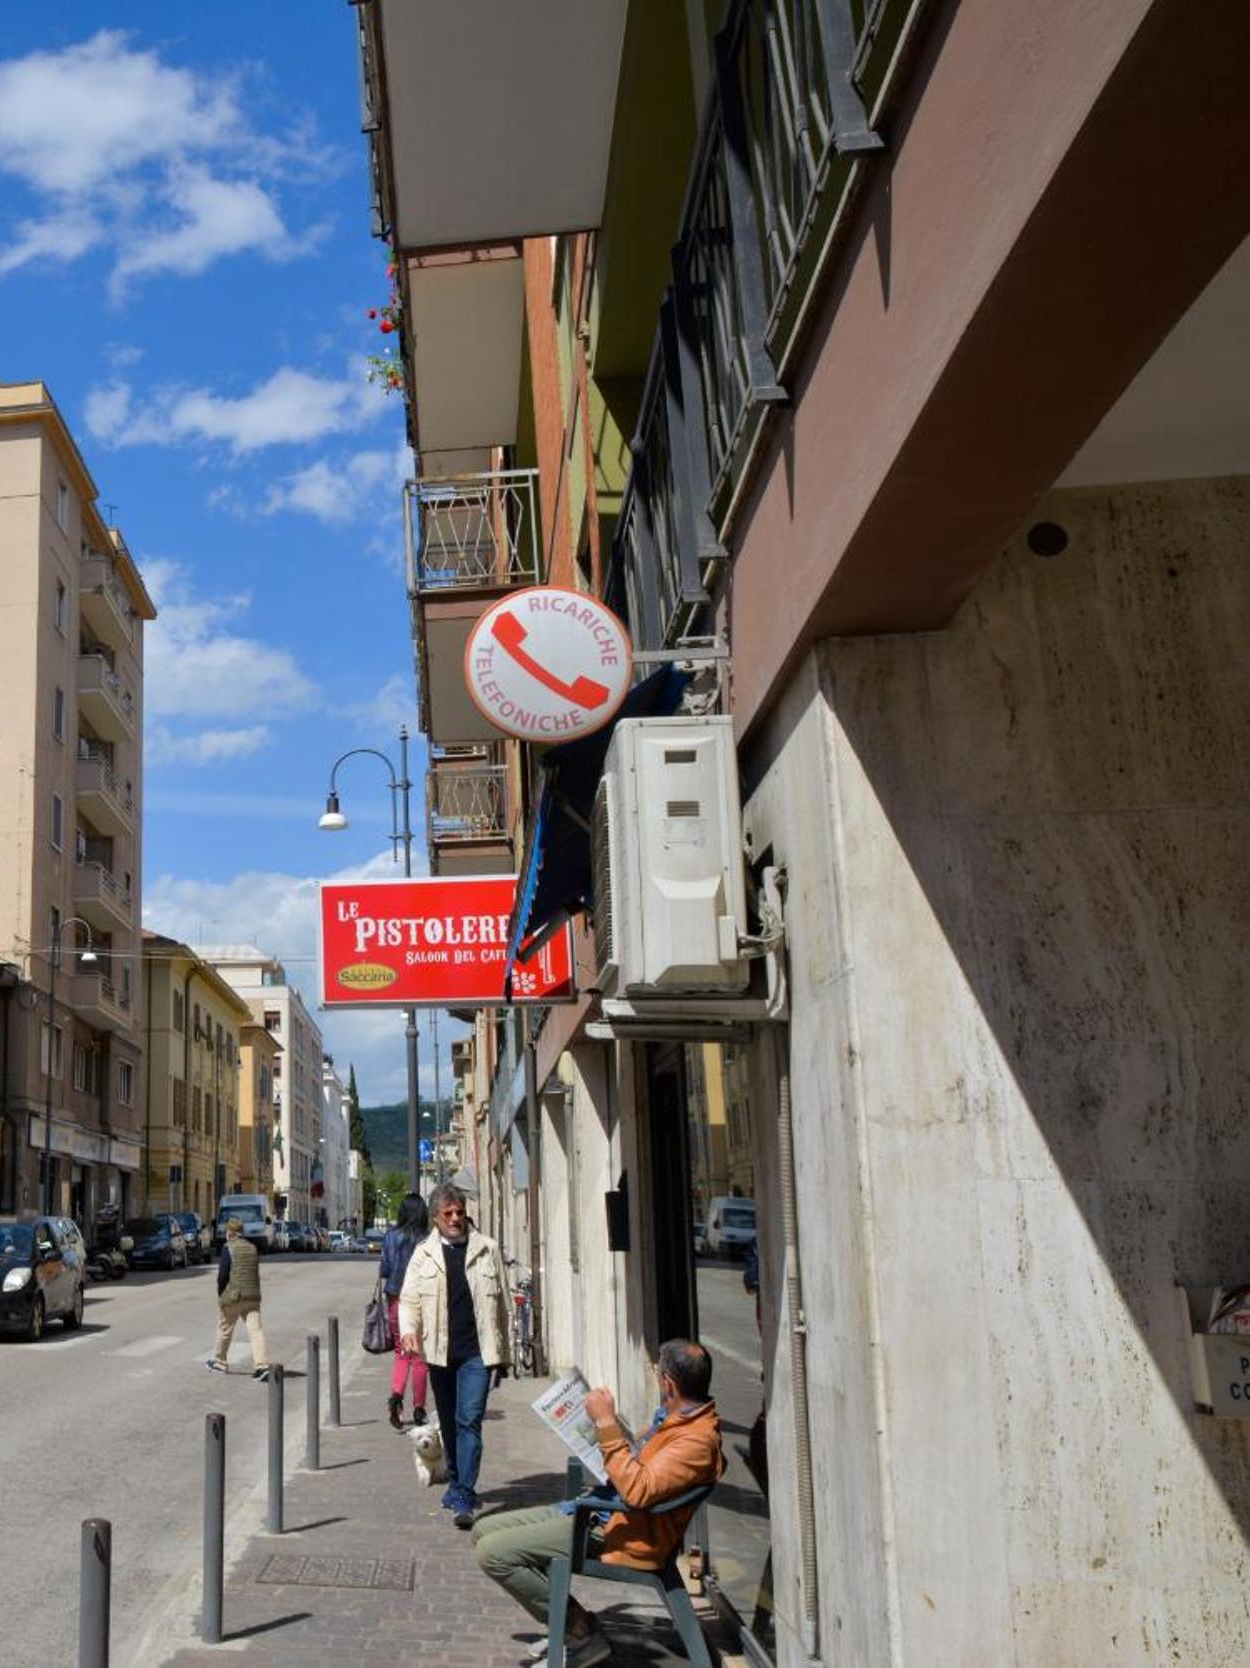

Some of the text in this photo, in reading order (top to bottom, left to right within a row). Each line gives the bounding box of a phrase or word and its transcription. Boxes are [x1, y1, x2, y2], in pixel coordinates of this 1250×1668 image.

[527, 595, 618, 667] RICARICHE
[475, 644, 585, 732] TELEFONICHE
[337, 901, 358, 922] LE
[406, 950, 448, 965] SALOON
[454, 949, 476, 964] DEL
